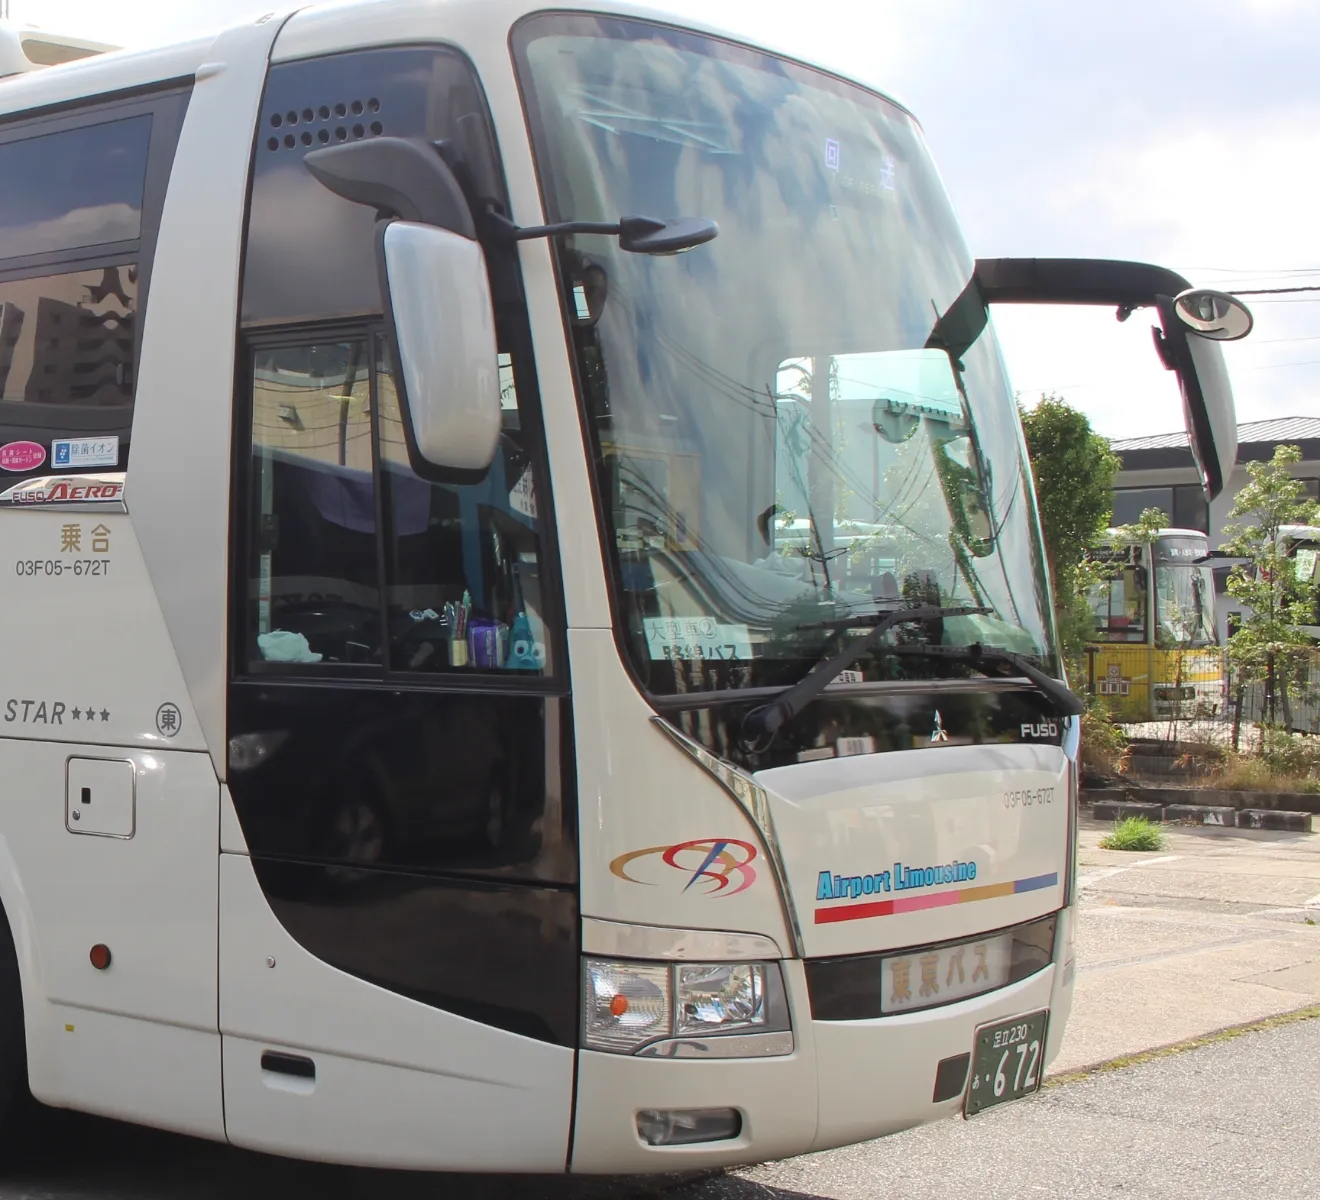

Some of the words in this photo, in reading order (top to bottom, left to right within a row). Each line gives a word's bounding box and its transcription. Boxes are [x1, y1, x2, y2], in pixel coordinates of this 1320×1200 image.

[71, 442, 115, 456] 除菌イオン
[12, 491, 44, 503] FUSO
[47, 483, 118, 501] AERO
[61, 524, 111, 552] 乗合
[16, 560, 110, 576] 03F05-672T
[4, 699, 66, 725] STAR
[1021, 723, 1058, 738] FUSO
[1003, 787, 1055, 809] 03F05-672T
[816, 870, 891, 900] Airport
[894, 860, 977, 891] Limousine
[890, 944, 989, 1004] 東京バス
